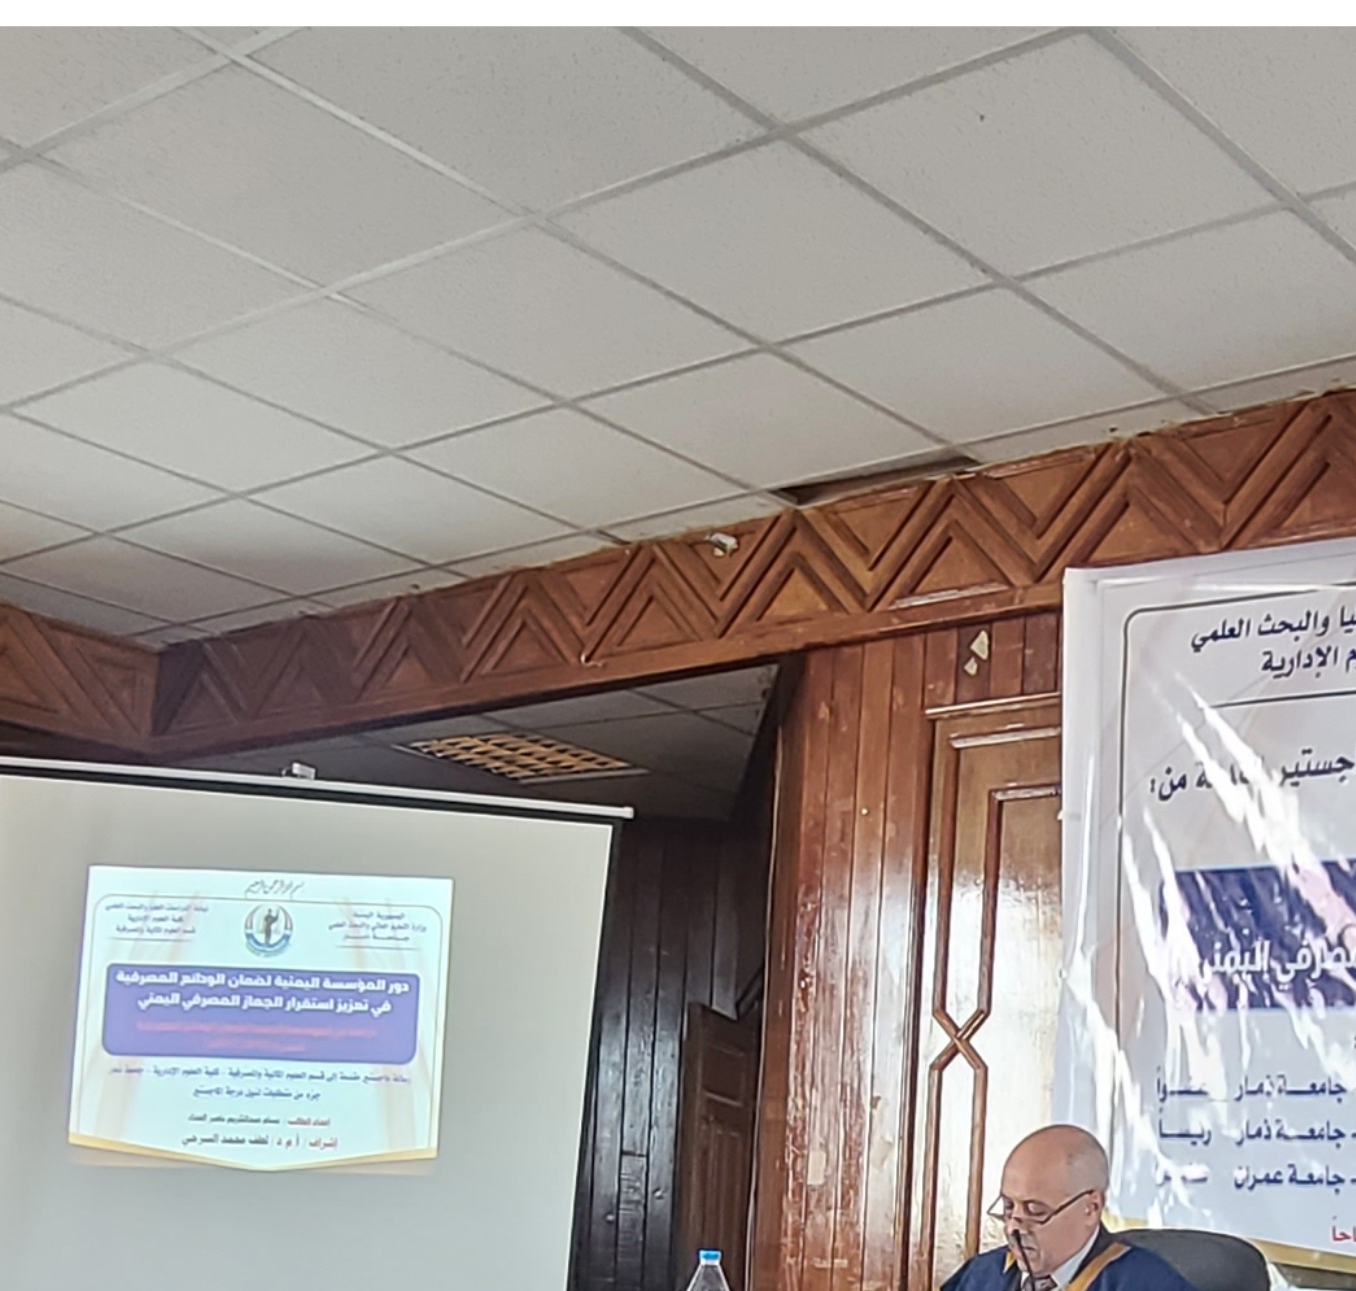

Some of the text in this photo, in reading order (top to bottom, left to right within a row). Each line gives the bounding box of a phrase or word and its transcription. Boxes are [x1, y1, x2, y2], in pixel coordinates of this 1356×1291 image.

[1258, 602, 1330, 641] والبحث
[1190, 614, 1250, 654] العلمي
[1261, 645, 1337, 678] الإدارية
[116, 970, 409, 994] دور المؤسسة اليمنية لضمان الودائع المصرفية
[138, 993, 180, 1010] اليمني
[182, 995, 240, 1011] المصرفي
[286, 998, 334, 1011] استقرار
[335, 1001, 368, 1013] تعزيز
[371, 1002, 392, 1015] في
[1289, 1164, 1345, 1195] جامعة
